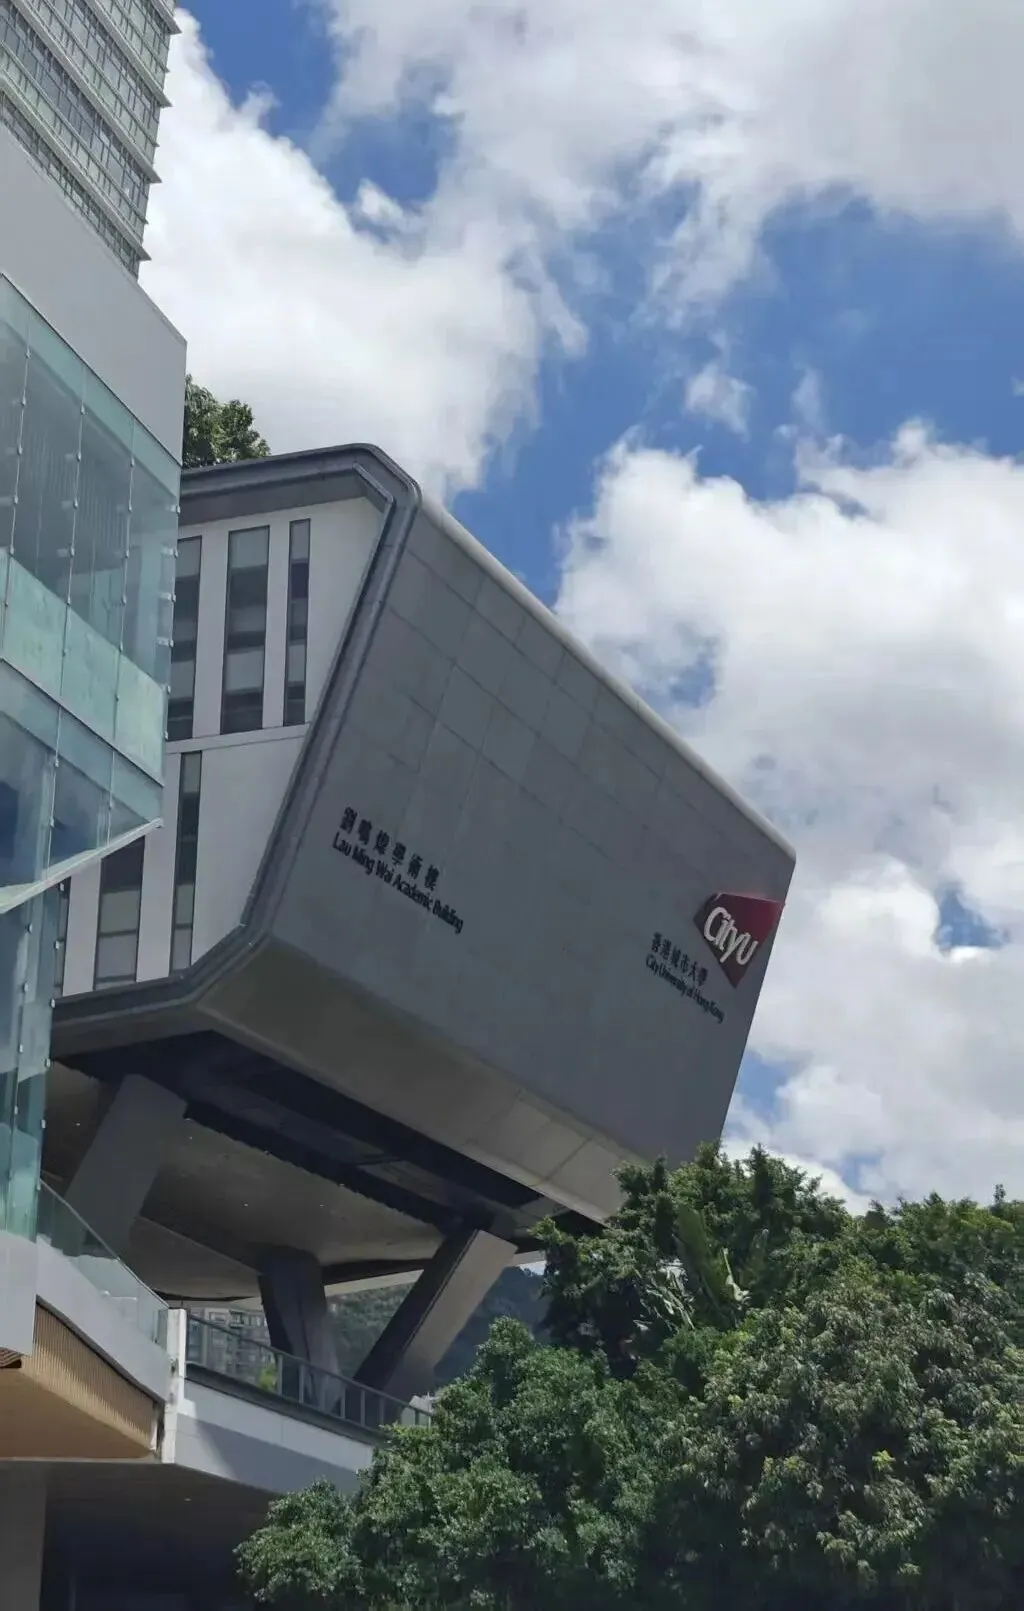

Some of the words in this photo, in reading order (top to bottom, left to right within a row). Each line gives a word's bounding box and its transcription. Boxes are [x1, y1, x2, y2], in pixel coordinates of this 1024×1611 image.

[332, 831, 351, 856] Lau
[352, 845, 375, 876] Ming
[376, 860, 394, 884] Wai
[392, 874, 433, 911] Academic
[432, 900, 463, 935] Building
[645, 953, 661, 975] City
[703, 906, 759, 965] CityU
